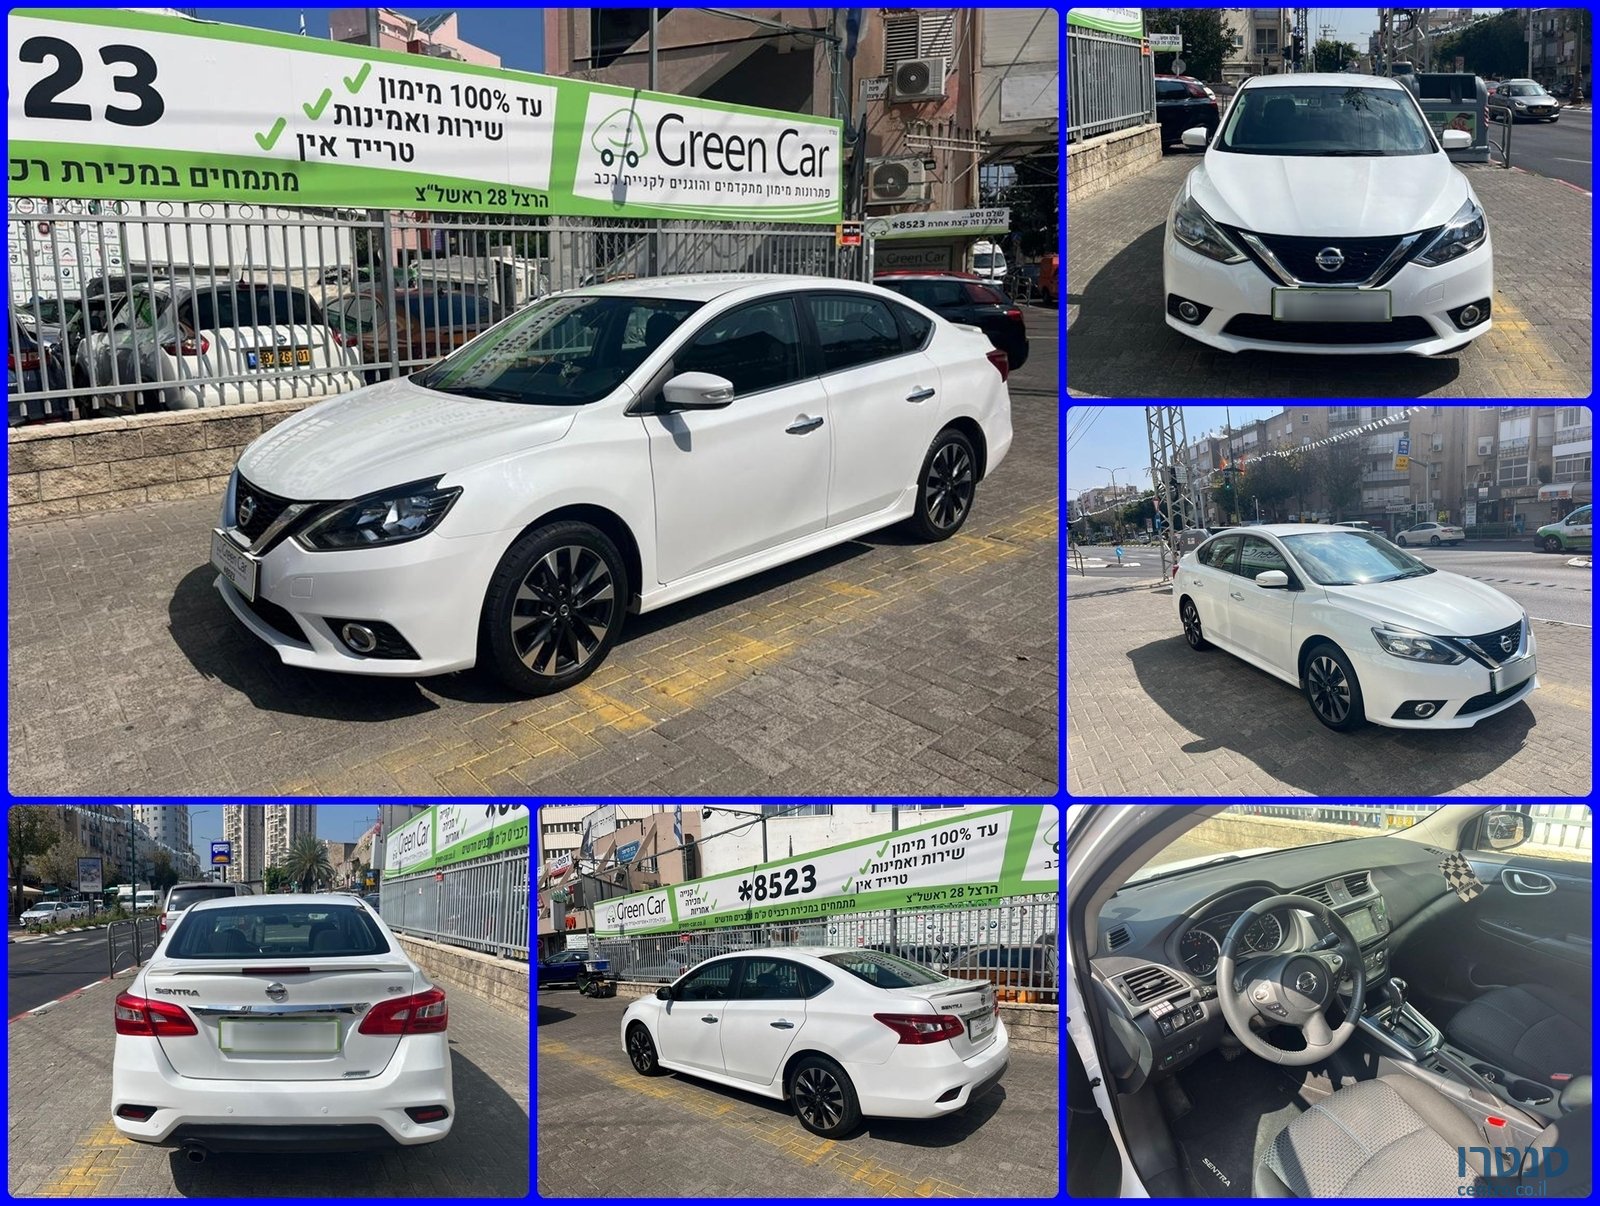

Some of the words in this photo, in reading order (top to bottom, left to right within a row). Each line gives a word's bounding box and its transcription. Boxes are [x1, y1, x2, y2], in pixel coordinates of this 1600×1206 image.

[379, 76, 442, 105] מימון
[450, 84, 510, 113] 100%
[516, 96, 543, 117] עד
[334, 103, 429, 133] ואמינות
[438, 115, 503, 141] שירות
[297, 133, 338, 162] אין
[347, 137, 415, 163] טרייד
[655, 112, 766, 173] Green
[777, 128, 830, 178] Car
[8, 158, 50, 182] רכ
[61, 160, 181, 187] במכירת
[190, 166, 299, 192] מתמחים
[487, 189, 507, 206] 28
[512, 190, 549, 208] הרצל
[766, 184, 792, 197] מימון
[399, 831, 416, 856] Green
[417, 821, 430, 847] Car
[931, 827, 972, 847] 100%
[977, 823, 999, 838] עד
[892, 837, 926, 858] מימון
[921, 847, 965, 866] שירות
[871, 856, 918, 875] ואמינות
[855, 878, 872, 894] אין
[876, 873, 908, 889] טרייד
[968, 883, 999, 897] הרצל
[950, 887, 965, 899] 28
[617, 902, 645, 921] Green
[647, 895, 666, 915] Car
[791, 903, 819, 915] במכירת
[821, 899, 856, 911] מתמחים
[155, 987, 200, 997] SENTRA
[1202, 1158, 1231, 1187] SENTRA
